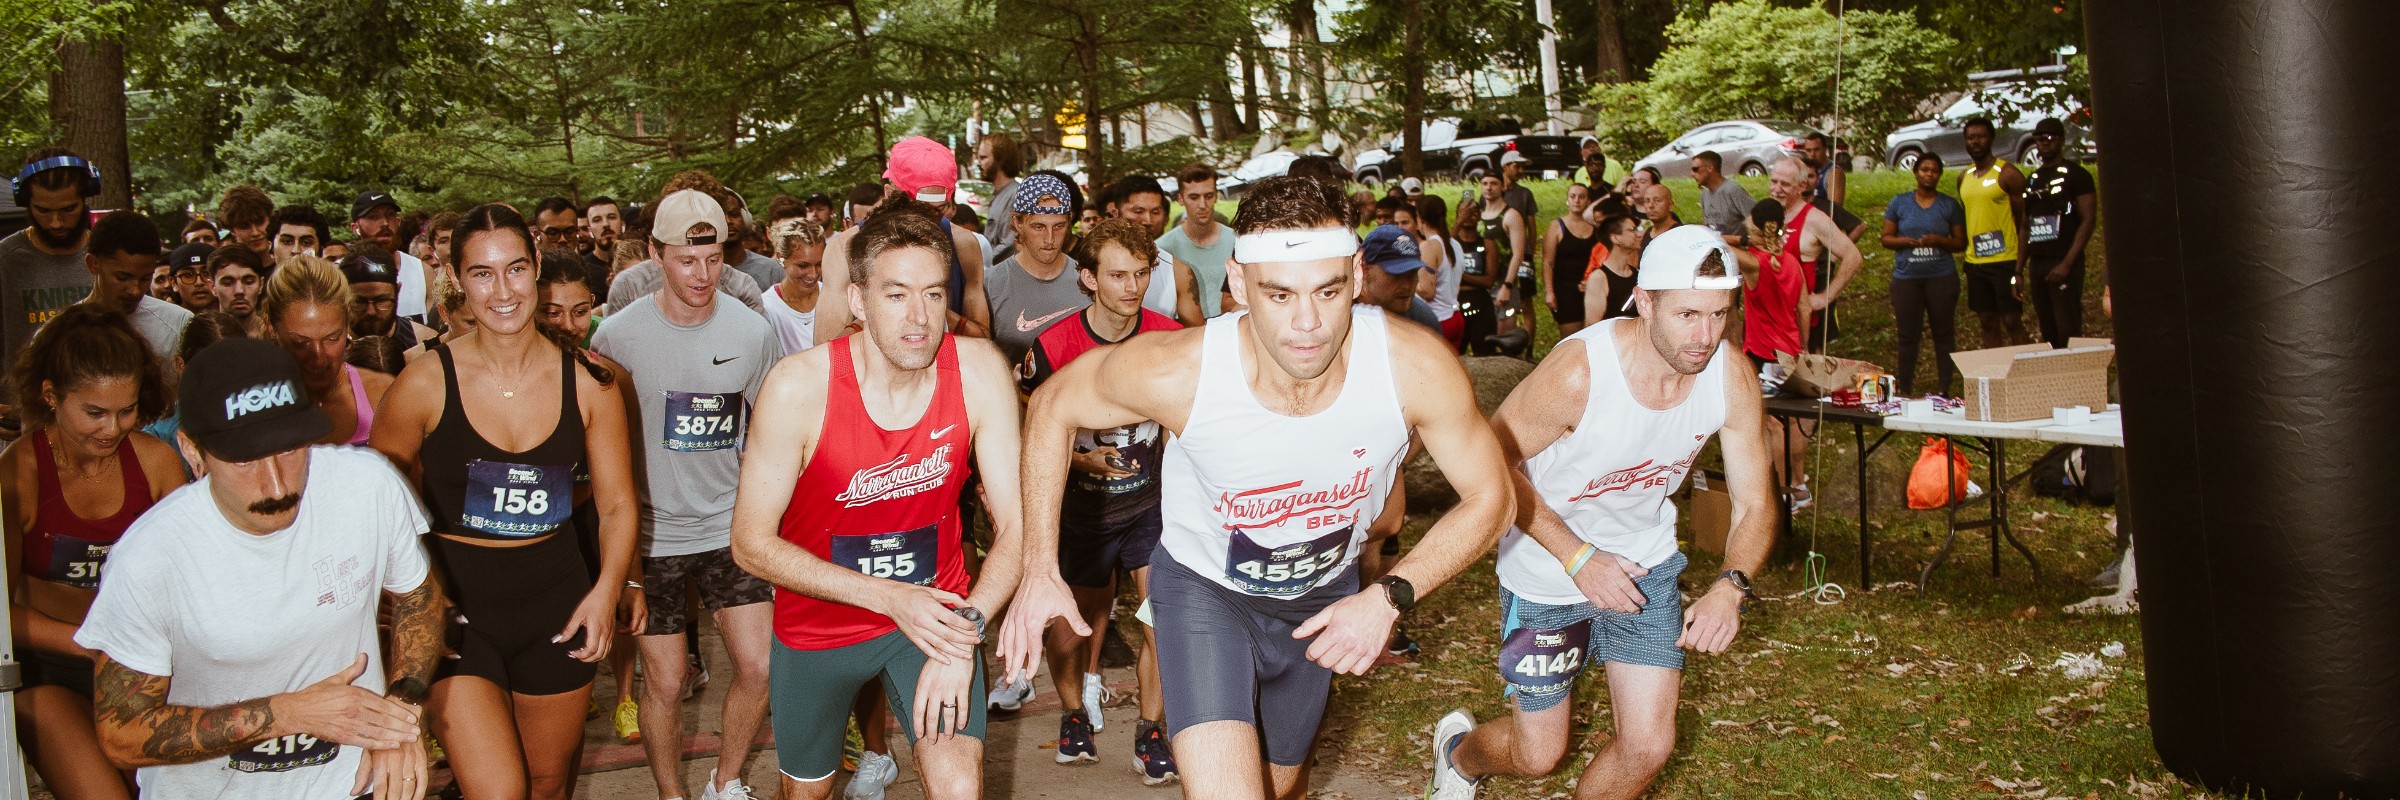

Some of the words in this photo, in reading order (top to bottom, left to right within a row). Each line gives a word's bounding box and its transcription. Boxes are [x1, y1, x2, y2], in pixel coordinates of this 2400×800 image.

[28, 309, 61, 324] BAS
[225, 383, 296, 420] HOKA
[674, 414, 734, 436] 3874
[834, 443, 951, 509] Narragansett
[893, 487, 915, 500] RUN
[916, 477, 945, 493] CLUB
[493, 486, 549, 516] 158
[1212, 465, 1375, 531] Narragansett
[65, 561, 104, 578] 31
[857, 551, 916, 579] 155
[1235, 543, 1346, 582] 4553
[1515, 646, 1580, 677] 4142
[253, 733, 318, 756] 419
